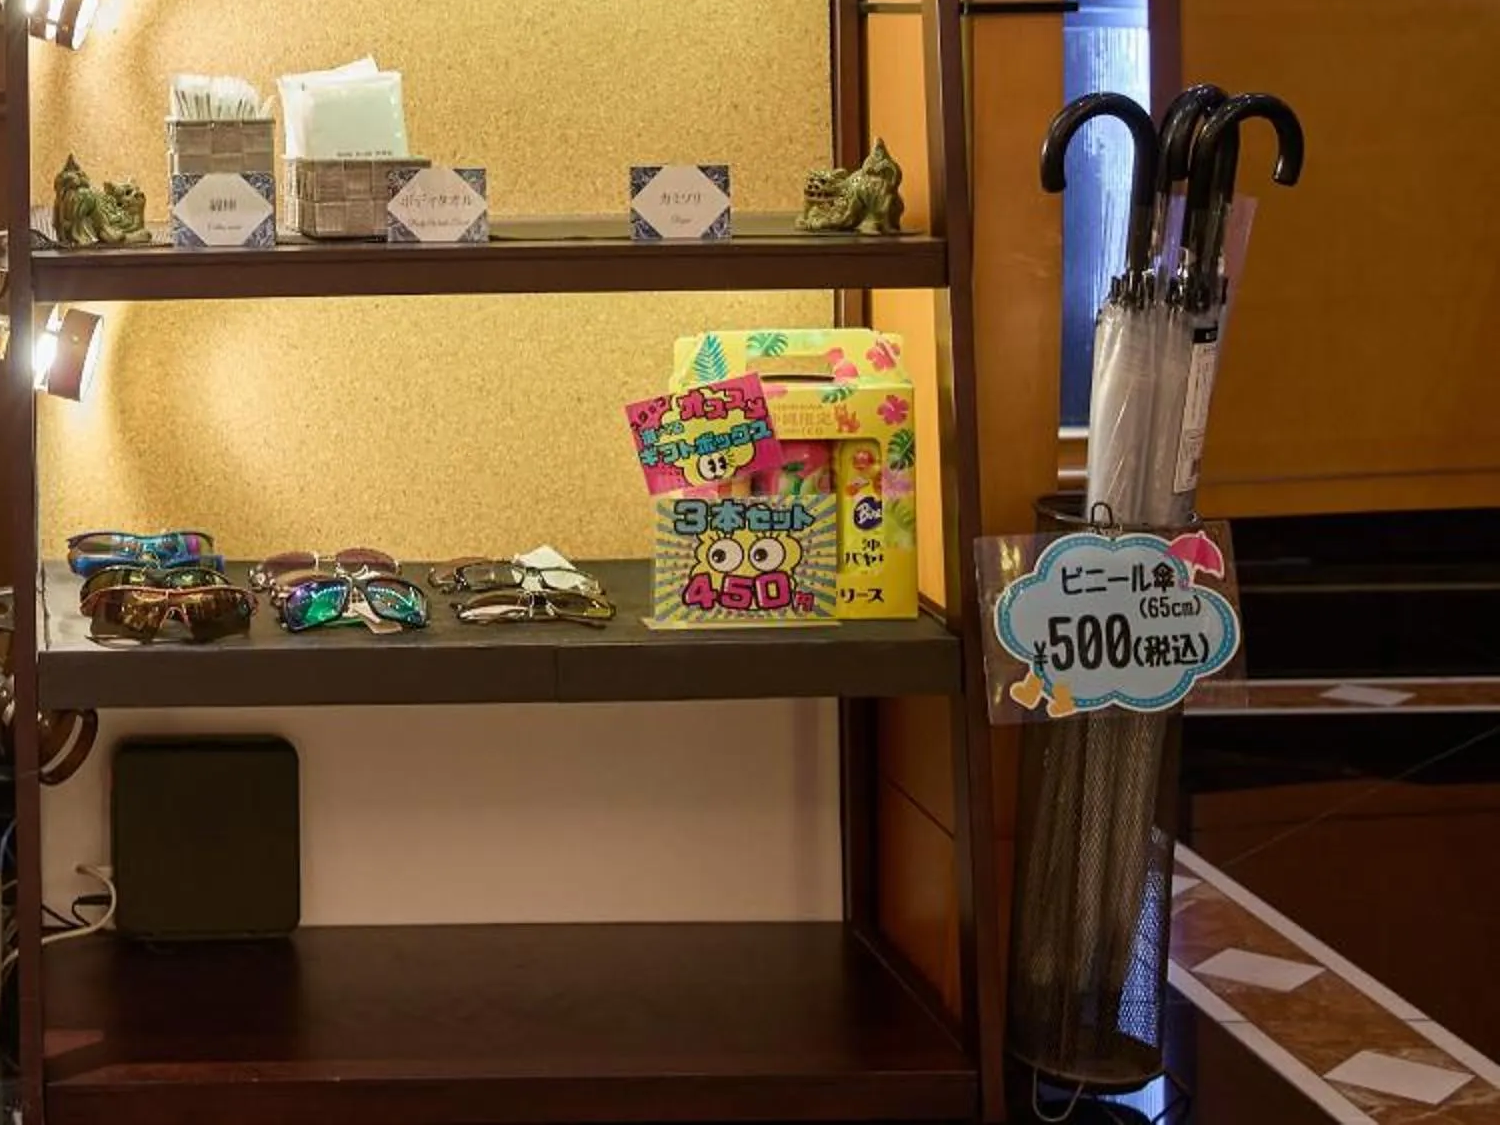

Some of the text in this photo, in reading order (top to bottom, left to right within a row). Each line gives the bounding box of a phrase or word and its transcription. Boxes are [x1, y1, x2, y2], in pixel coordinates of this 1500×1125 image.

[673, 497, 817, 535] 3本セット
[681, 571, 816, 613] 450円
[1061, 561, 1176, 596] ビニール傘
[1139, 594, 1202, 620] (65cm)
